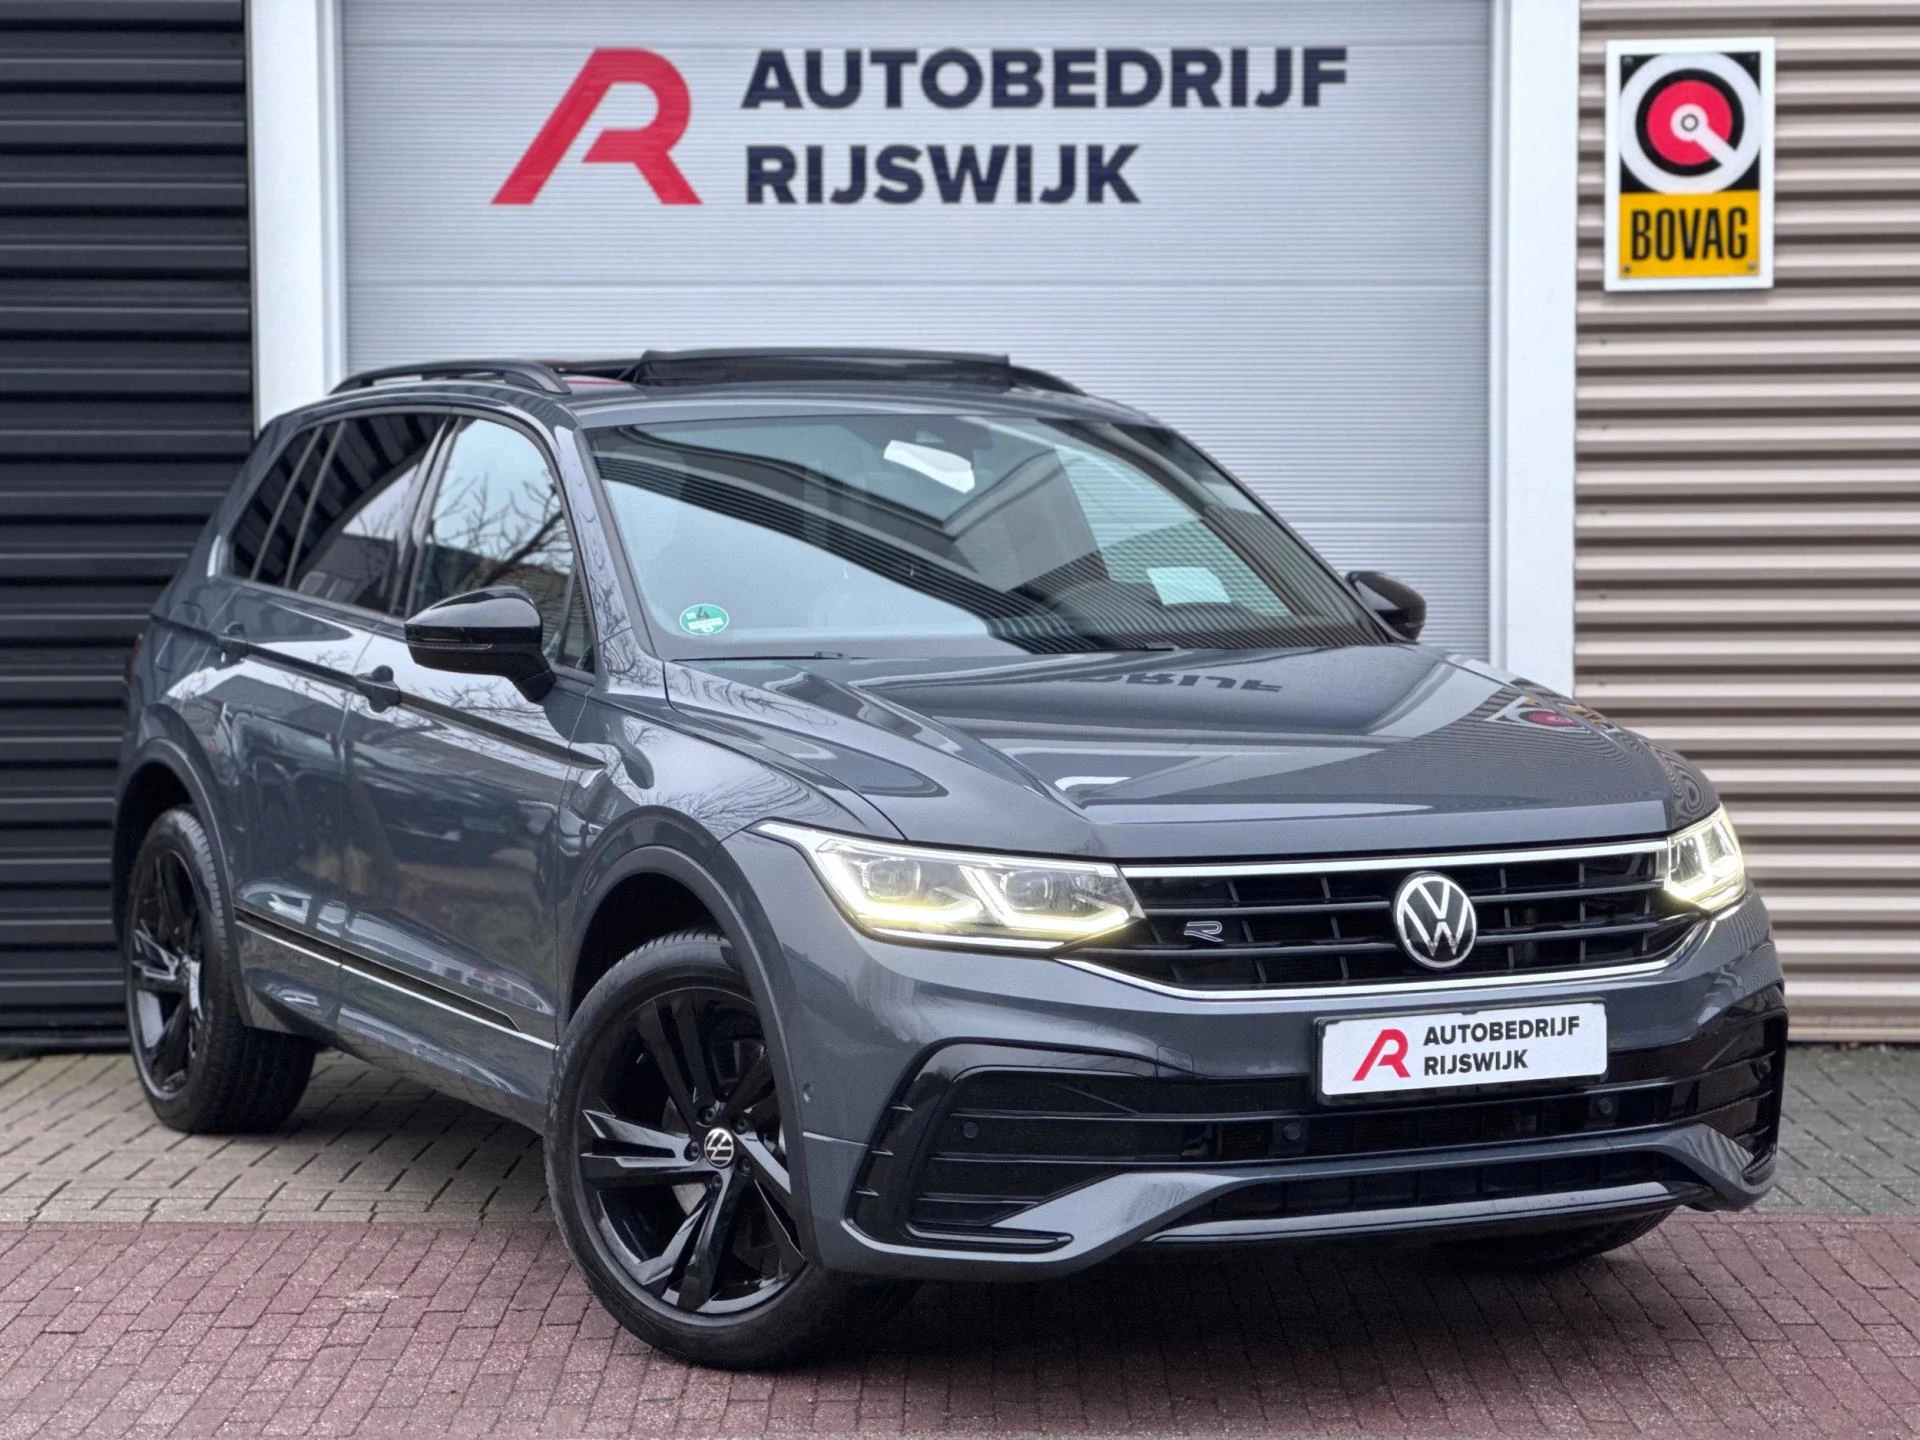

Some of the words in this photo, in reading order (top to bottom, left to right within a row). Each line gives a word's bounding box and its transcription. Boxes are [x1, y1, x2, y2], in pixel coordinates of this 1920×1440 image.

[741, 48, 1348, 109] AUTOBEDRIJF
[746, 144, 1141, 204] RIJSWIJK
[1631, 207, 1748, 262] BOVAG
[1400, 876, 1474, 963] VW
[1423, 1015, 1580, 1046] AUTOBEDRIJF
[1424, 1049, 1528, 1076] RIJSWIJK
